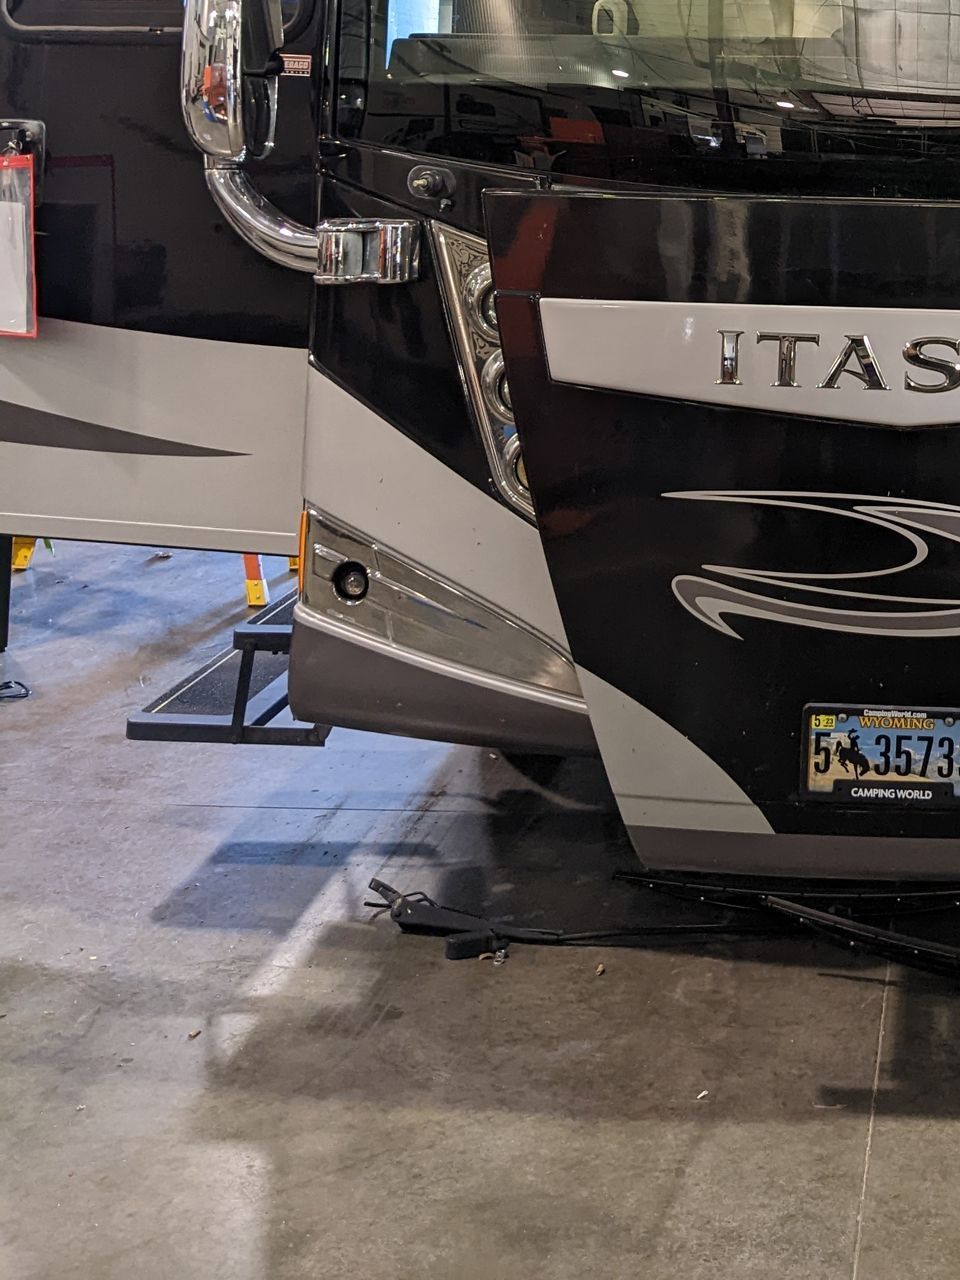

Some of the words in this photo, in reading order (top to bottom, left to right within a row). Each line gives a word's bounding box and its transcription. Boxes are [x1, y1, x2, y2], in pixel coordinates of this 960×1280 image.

[863, 708, 928, 719] CampingWorld.com
[858, 716, 936, 730] WYOMING
[813, 731, 832, 774] 5
[851, 787, 896, 799] CAMPING
[896, 788, 933, 800] WORLD
